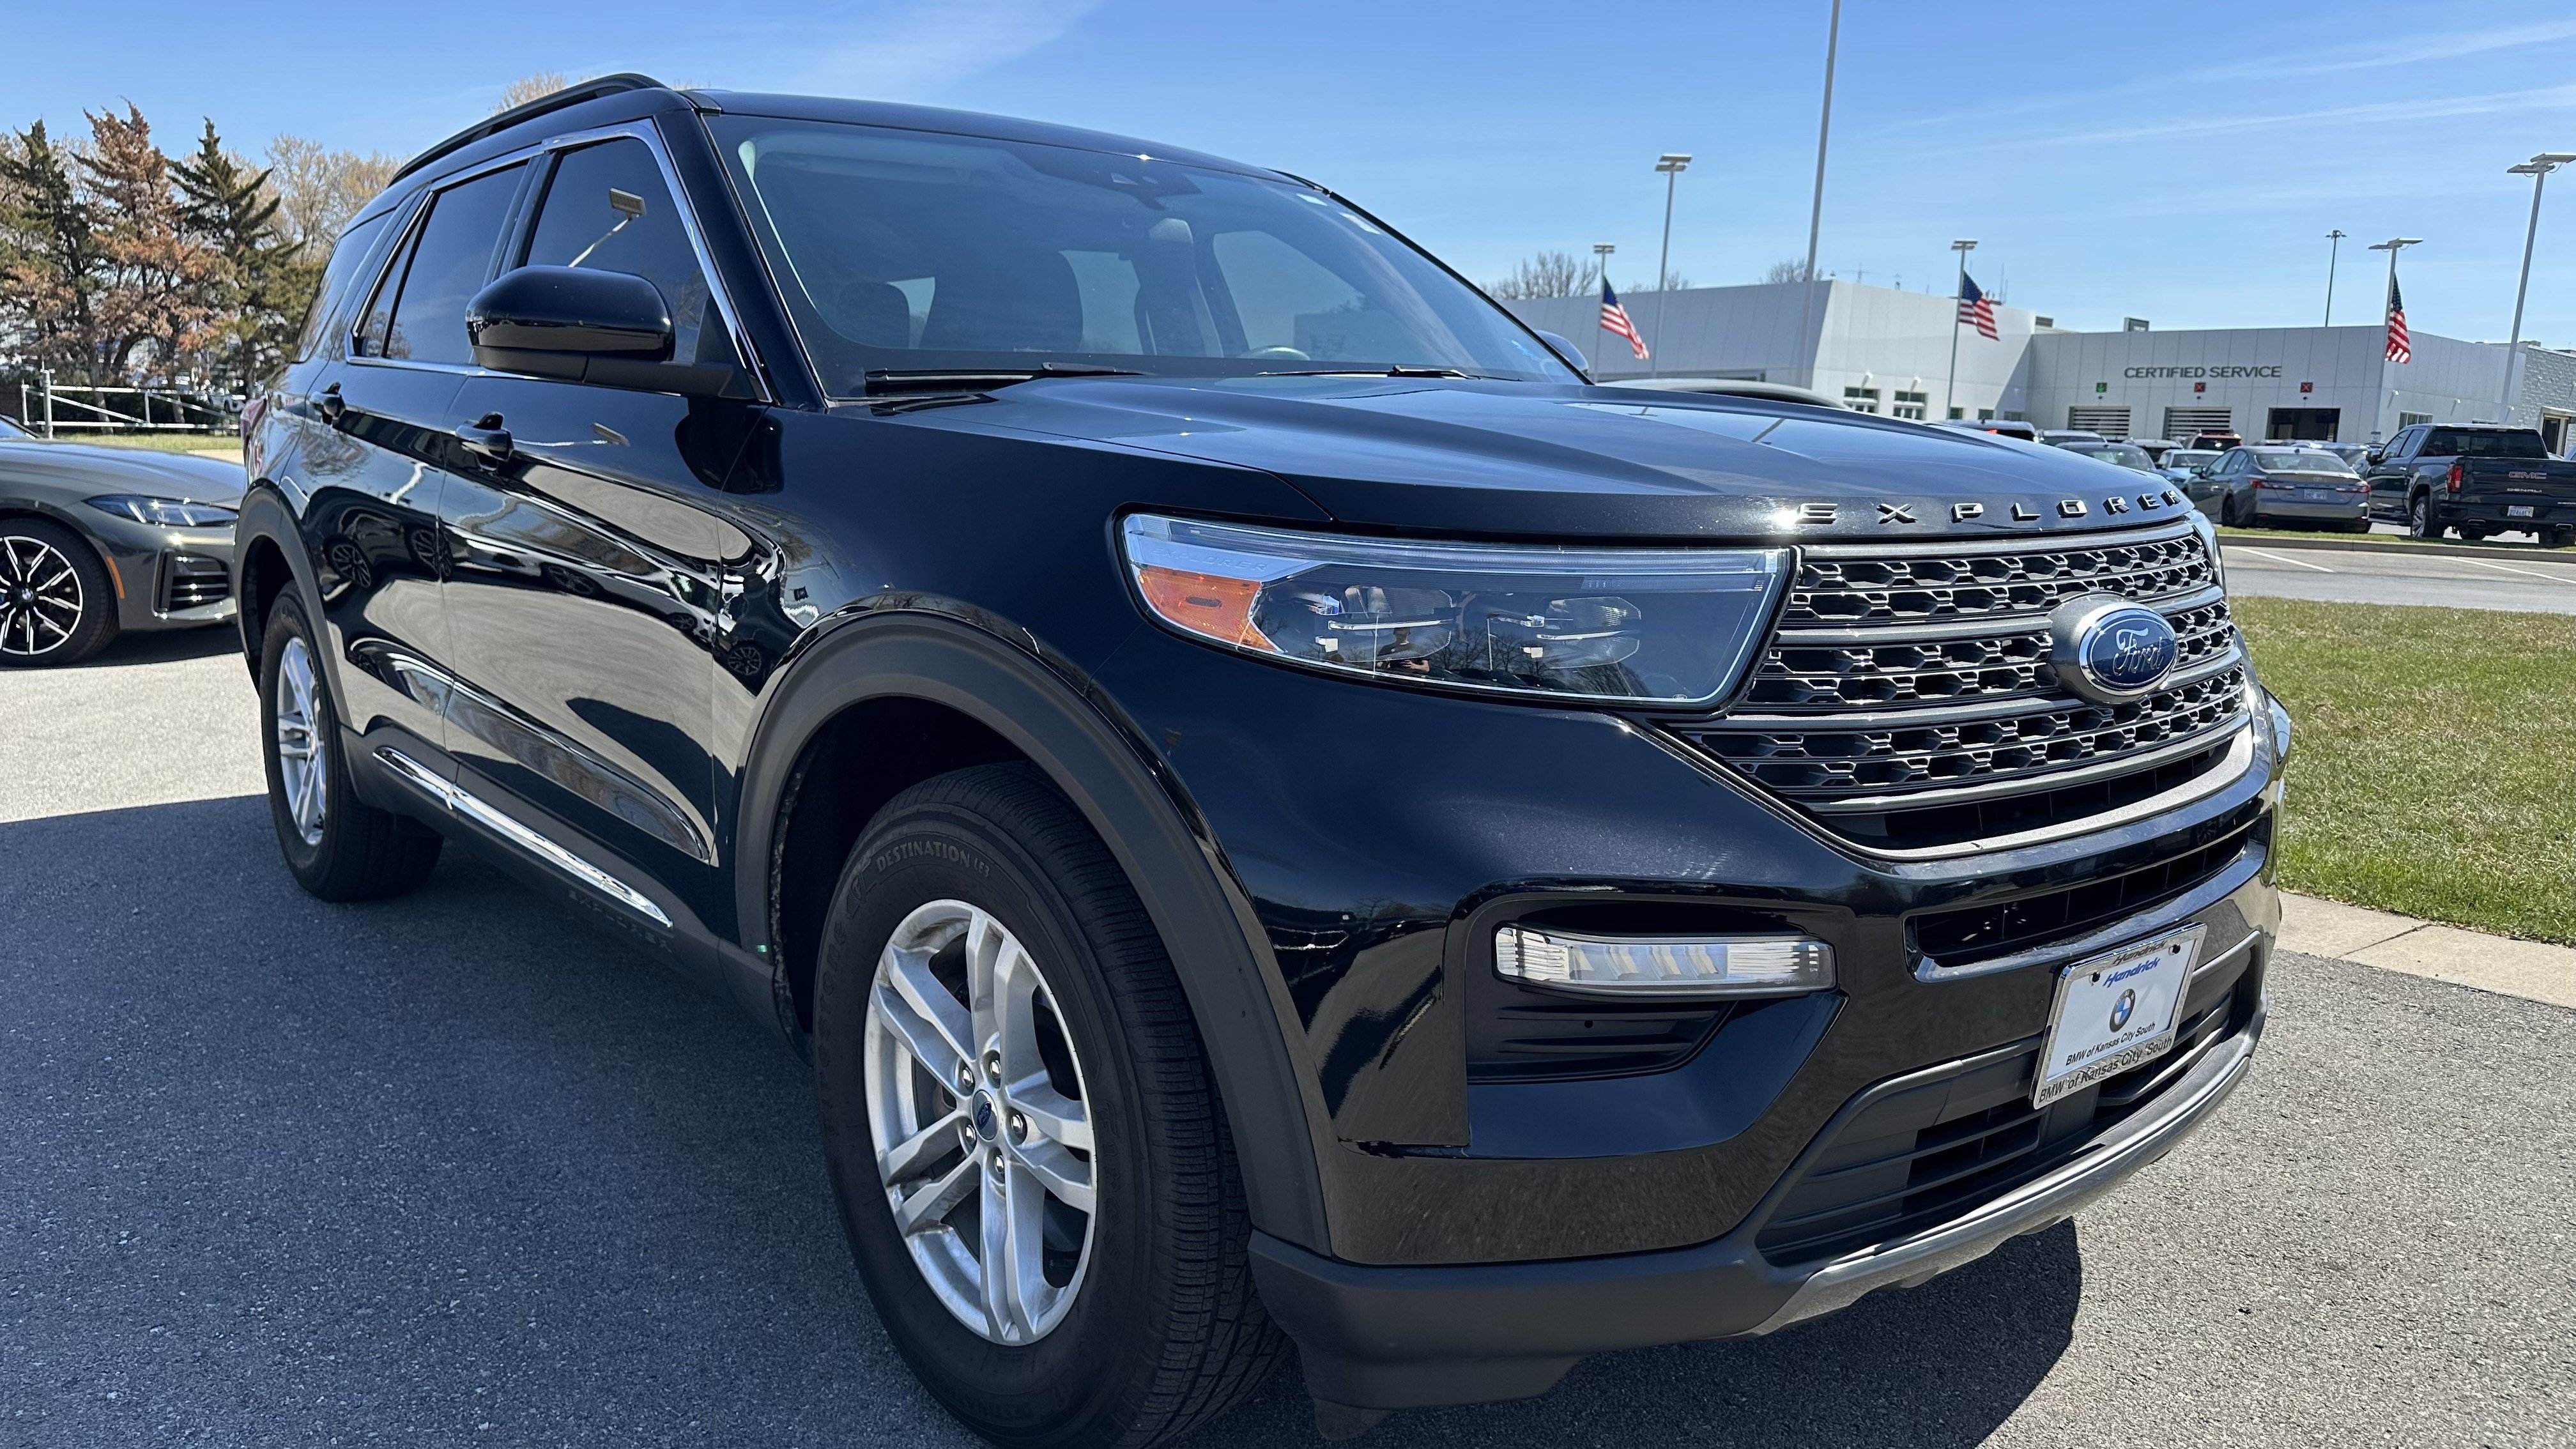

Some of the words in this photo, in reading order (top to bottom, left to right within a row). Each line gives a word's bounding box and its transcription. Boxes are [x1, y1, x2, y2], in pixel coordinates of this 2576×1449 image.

[2124, 367, 2206, 379] CERTIFIED
[2209, 365, 2282, 378] SERVICE
[2508, 471, 2547, 479] GMC
[1796, 489, 2181, 525] EXPLORER
[1150, 548, 1269, 572] EXPLORER
[2113, 627, 2164, 676] Ford
[876, 840, 970, 873] DESTINATION
[973, 857, 990, 878] LE3
[2103, 956, 2161, 988] Hendrick
[2066, 1048, 2087, 1066] BMW
[2087, 1045, 2096, 1058] of
[2096, 1036, 2120, 1053] Kansas
[2120, 1031, 2135, 1043] City
[2135, 1022, 2156, 1038] South
[2039, 1079, 2066, 1103] BMW
[2067, 1075, 2079, 1089] of
[2080, 1059, 2119, 1084] Kansas
[2122, 1048, 2142, 1064] City
[2147, 1036, 2172, 1055] South
